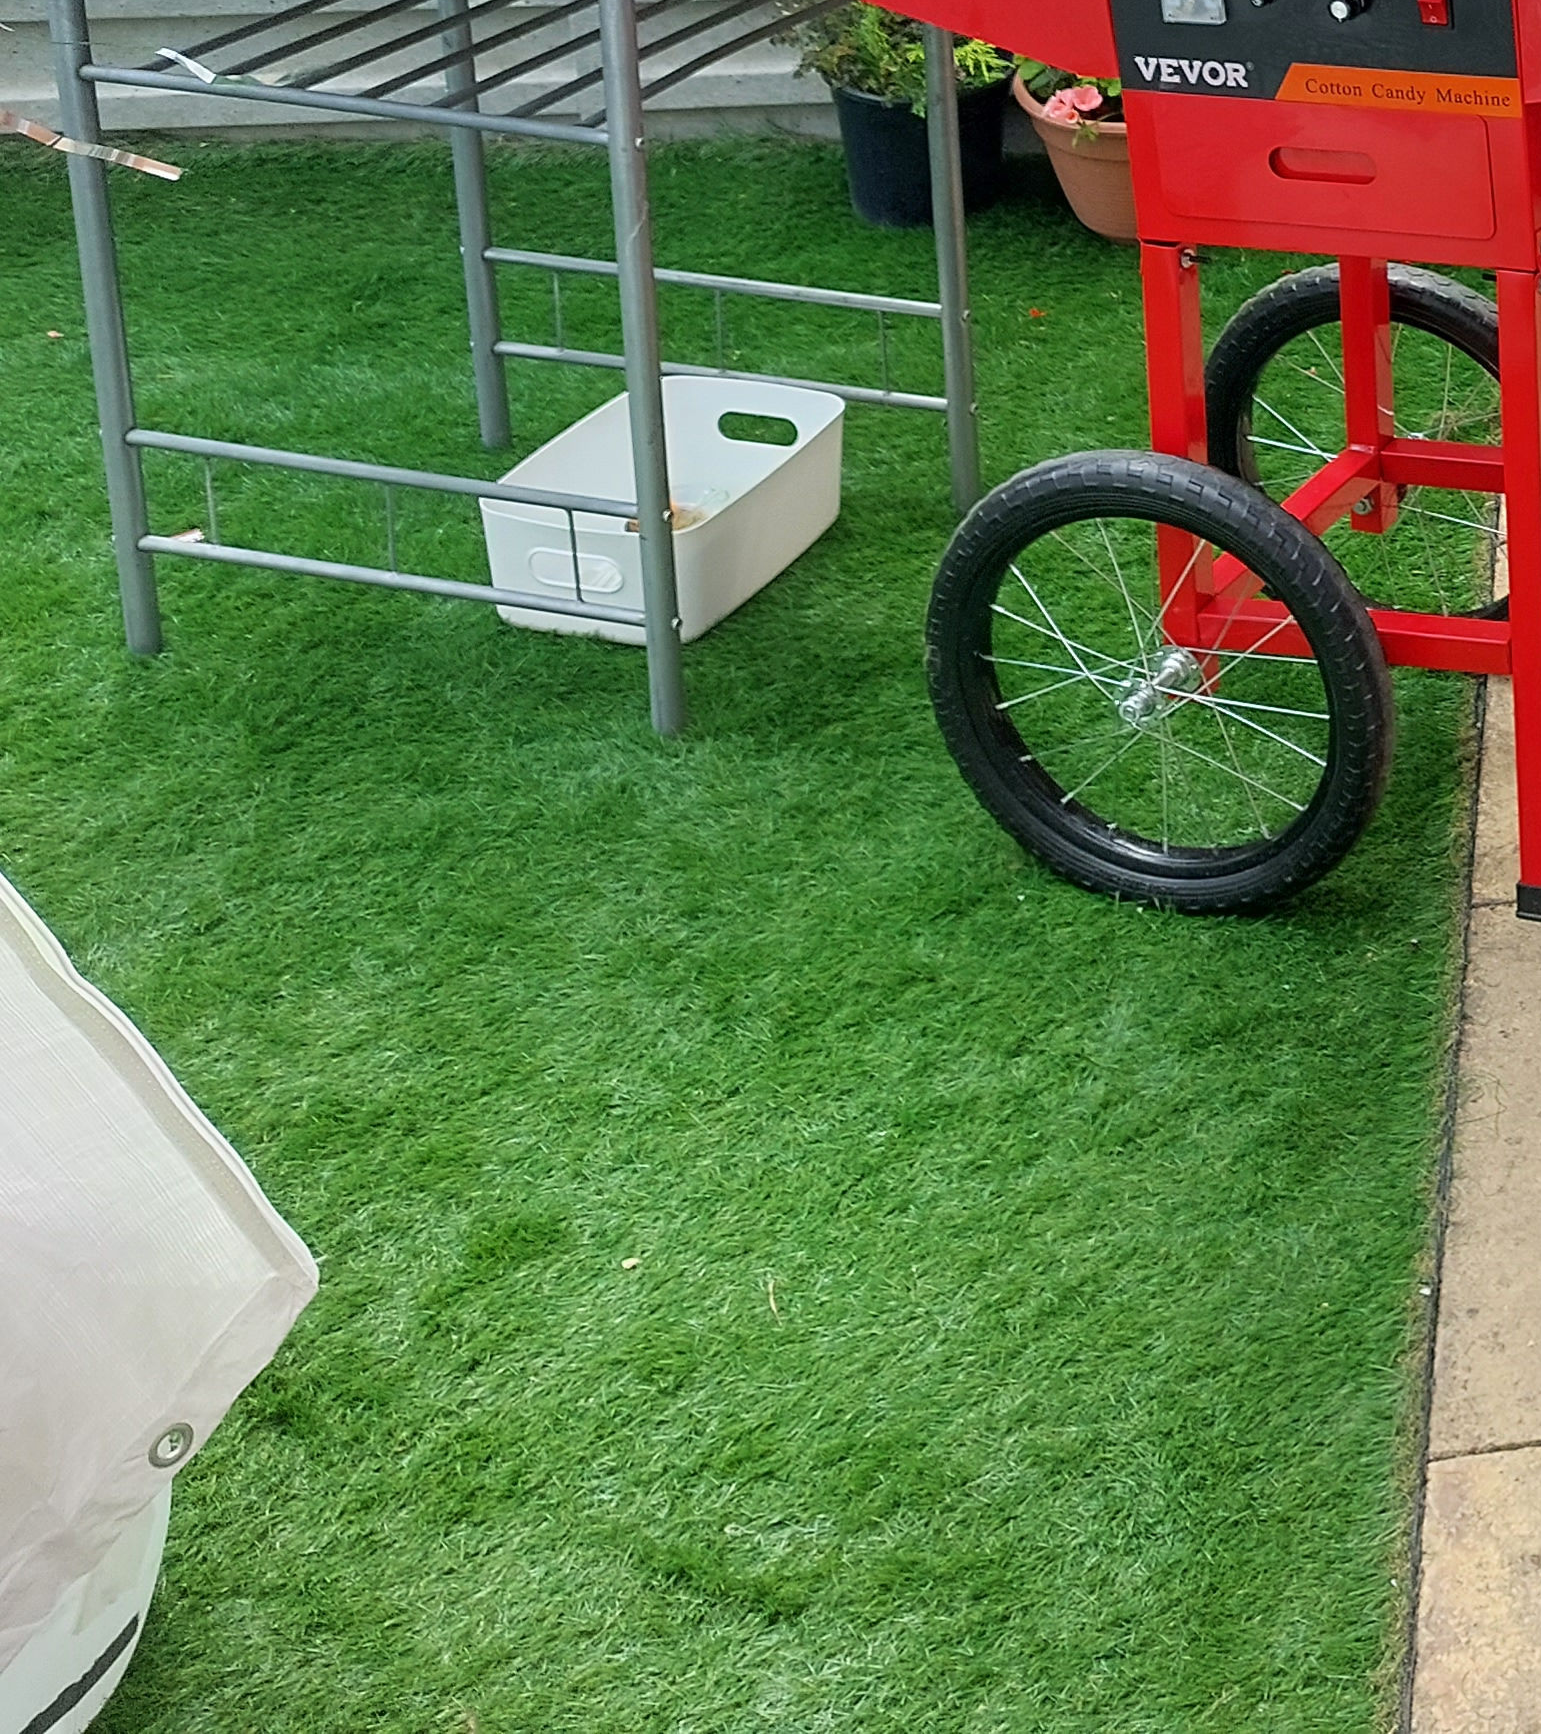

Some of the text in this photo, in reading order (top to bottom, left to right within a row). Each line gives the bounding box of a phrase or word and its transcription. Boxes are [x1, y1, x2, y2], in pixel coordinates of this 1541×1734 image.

[1134, 56, 1250, 88] VEVOR
[1305, 79, 1512, 108] Cotton Candy Machine
